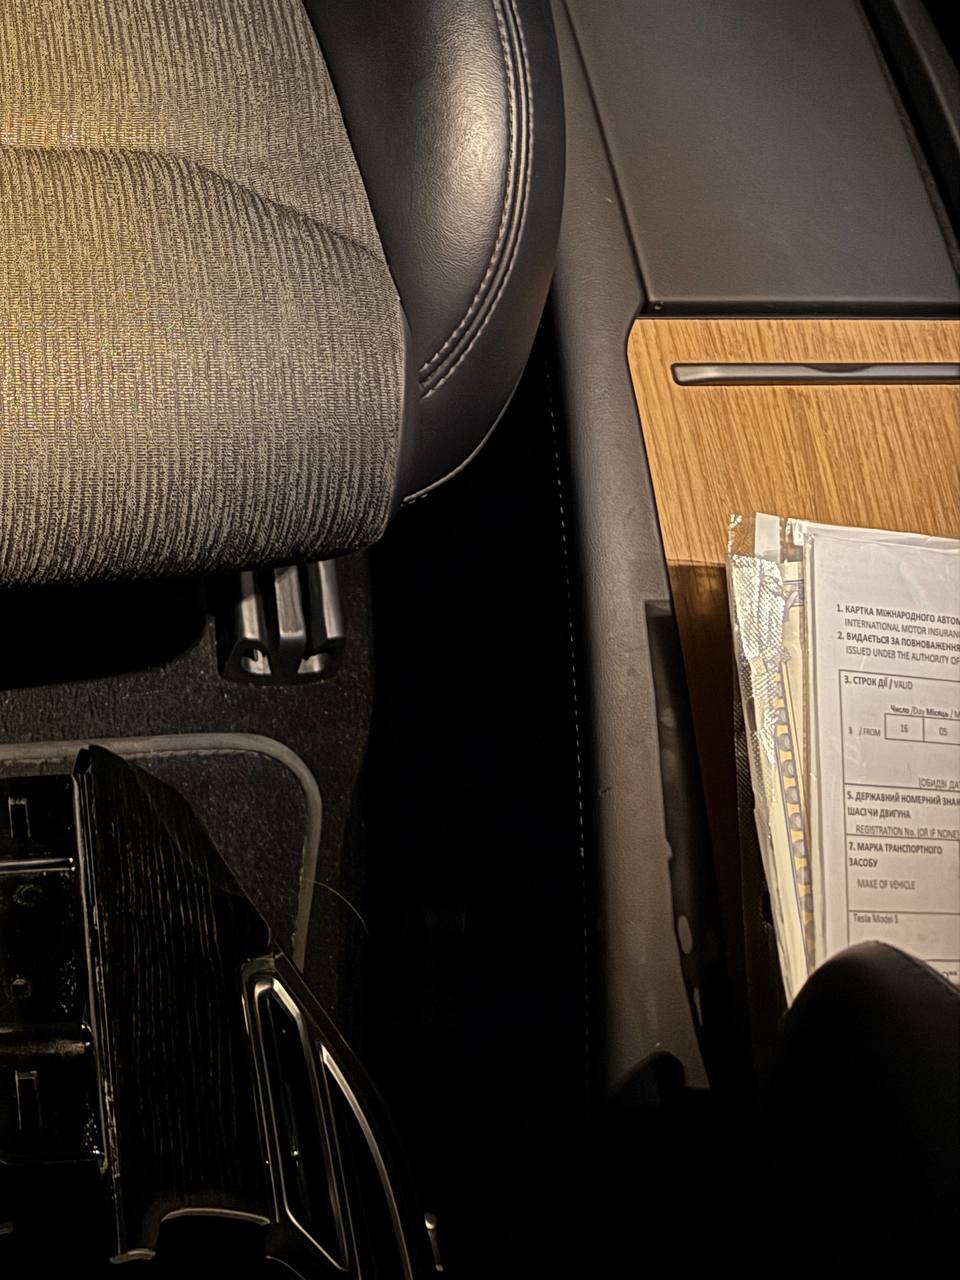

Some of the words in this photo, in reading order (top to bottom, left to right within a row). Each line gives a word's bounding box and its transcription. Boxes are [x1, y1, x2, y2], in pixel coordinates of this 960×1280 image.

[837, 604, 844, 612] 1.
[845, 605, 874, 616] КАРТКА
[876, 608, 935, 623] МІЖНАРОДНОГО
[845, 618, 900, 632] INTERNATIONAL
[901, 624, 927, 635] MOTOR
[928, 627, 960, 638] INSURAN
[837, 631, 844, 640] 2.
[846, 632, 889, 644] ВИДАЄТЬСЯ
[891, 637, 900, 645] ЗА
[846, 646, 871, 657] ISSUED
[873, 649, 896, 659] UNDER
[897, 651, 910, 660] THE
[911, 652, 949, 664] AUTHORITY
[844, 675, 852, 684] 3.
[853, 676, 877, 686] СТРОК
[893, 680, 913, 690] VALID
[890, 705, 909, 714] Число
[847, 791, 854, 800] 5.
[855, 791, 899, 802] ДЕРЖАВНИЙ
[901, 795, 941, 806] НОМЕРНИЙ
[879, 809, 911, 819] ДВИГУНА
[856, 825, 903, 835] REGISTRATION
[857, 842, 883, 852] МАРКА
[885, 844, 943, 855] ТРАНСПОРТНОГО
[849, 858, 878, 868] ЗАСОБУ
[857, 879, 878, 889] MAKE
[879, 880, 888, 889] OF
[889, 880, 916, 890] VEHICLE
[853, 913, 871, 923] Tesla
[873, 914, 893, 923] Model
